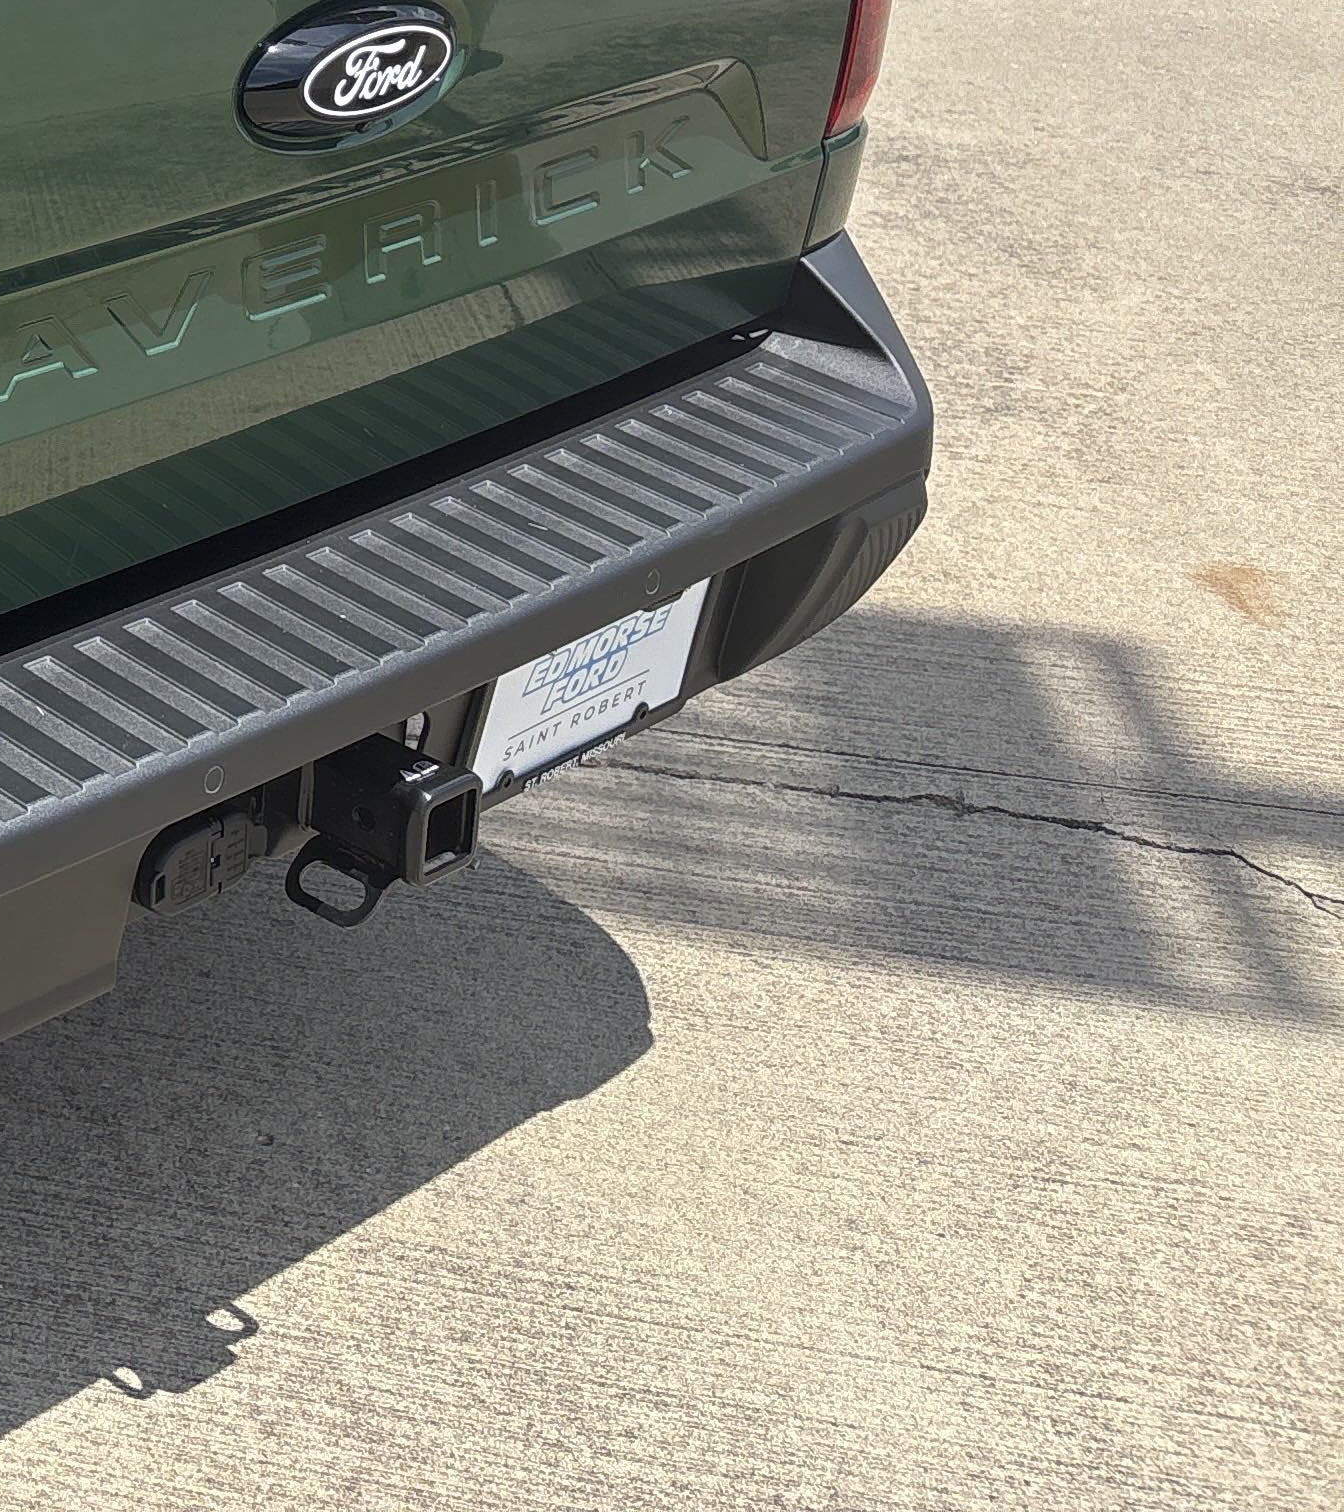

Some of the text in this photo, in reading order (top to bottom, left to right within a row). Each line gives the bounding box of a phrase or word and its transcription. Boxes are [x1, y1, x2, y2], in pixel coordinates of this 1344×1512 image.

[333, 38, 427, 107] Ford
[540, 648, 629, 716] FORD
[502, 679, 647, 762] SAINT ROBERT
[580, 731, 627, 764] MISSOURI
